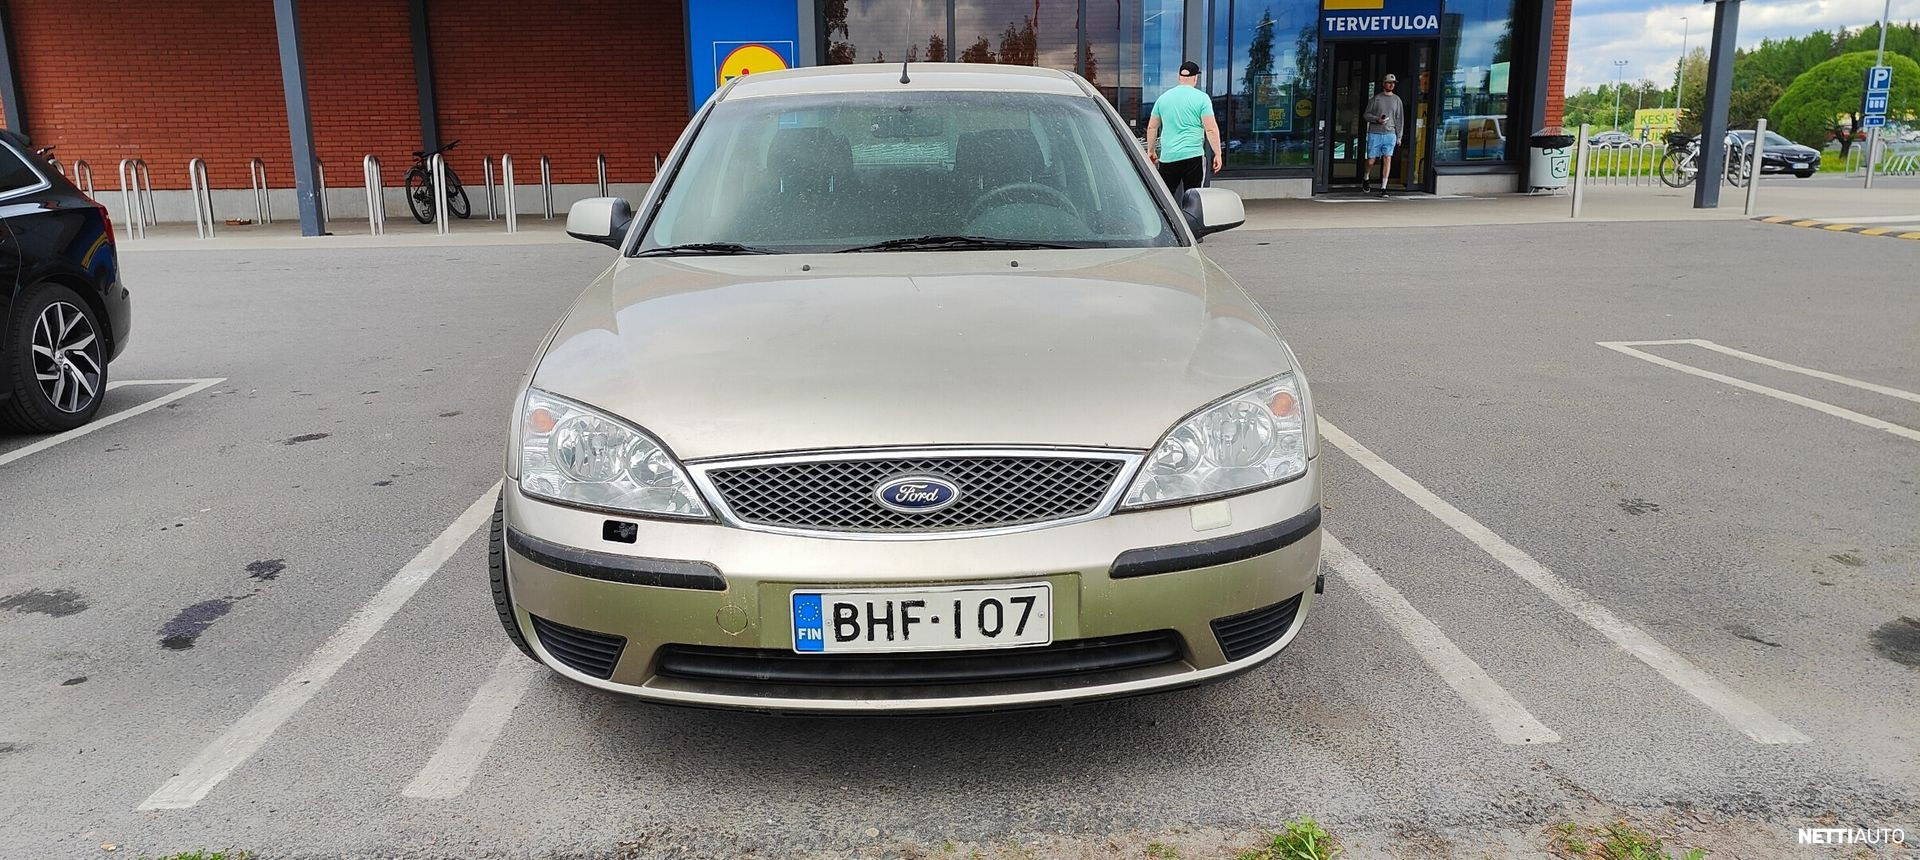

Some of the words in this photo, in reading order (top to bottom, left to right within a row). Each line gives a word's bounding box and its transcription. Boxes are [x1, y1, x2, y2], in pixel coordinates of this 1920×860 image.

[1326, 15, 1439, 31] TERVETULOA
[1873, 69, 1888, 88] P
[896, 485, 938, 502] Ford
[798, 628, 822, 640] FIN
